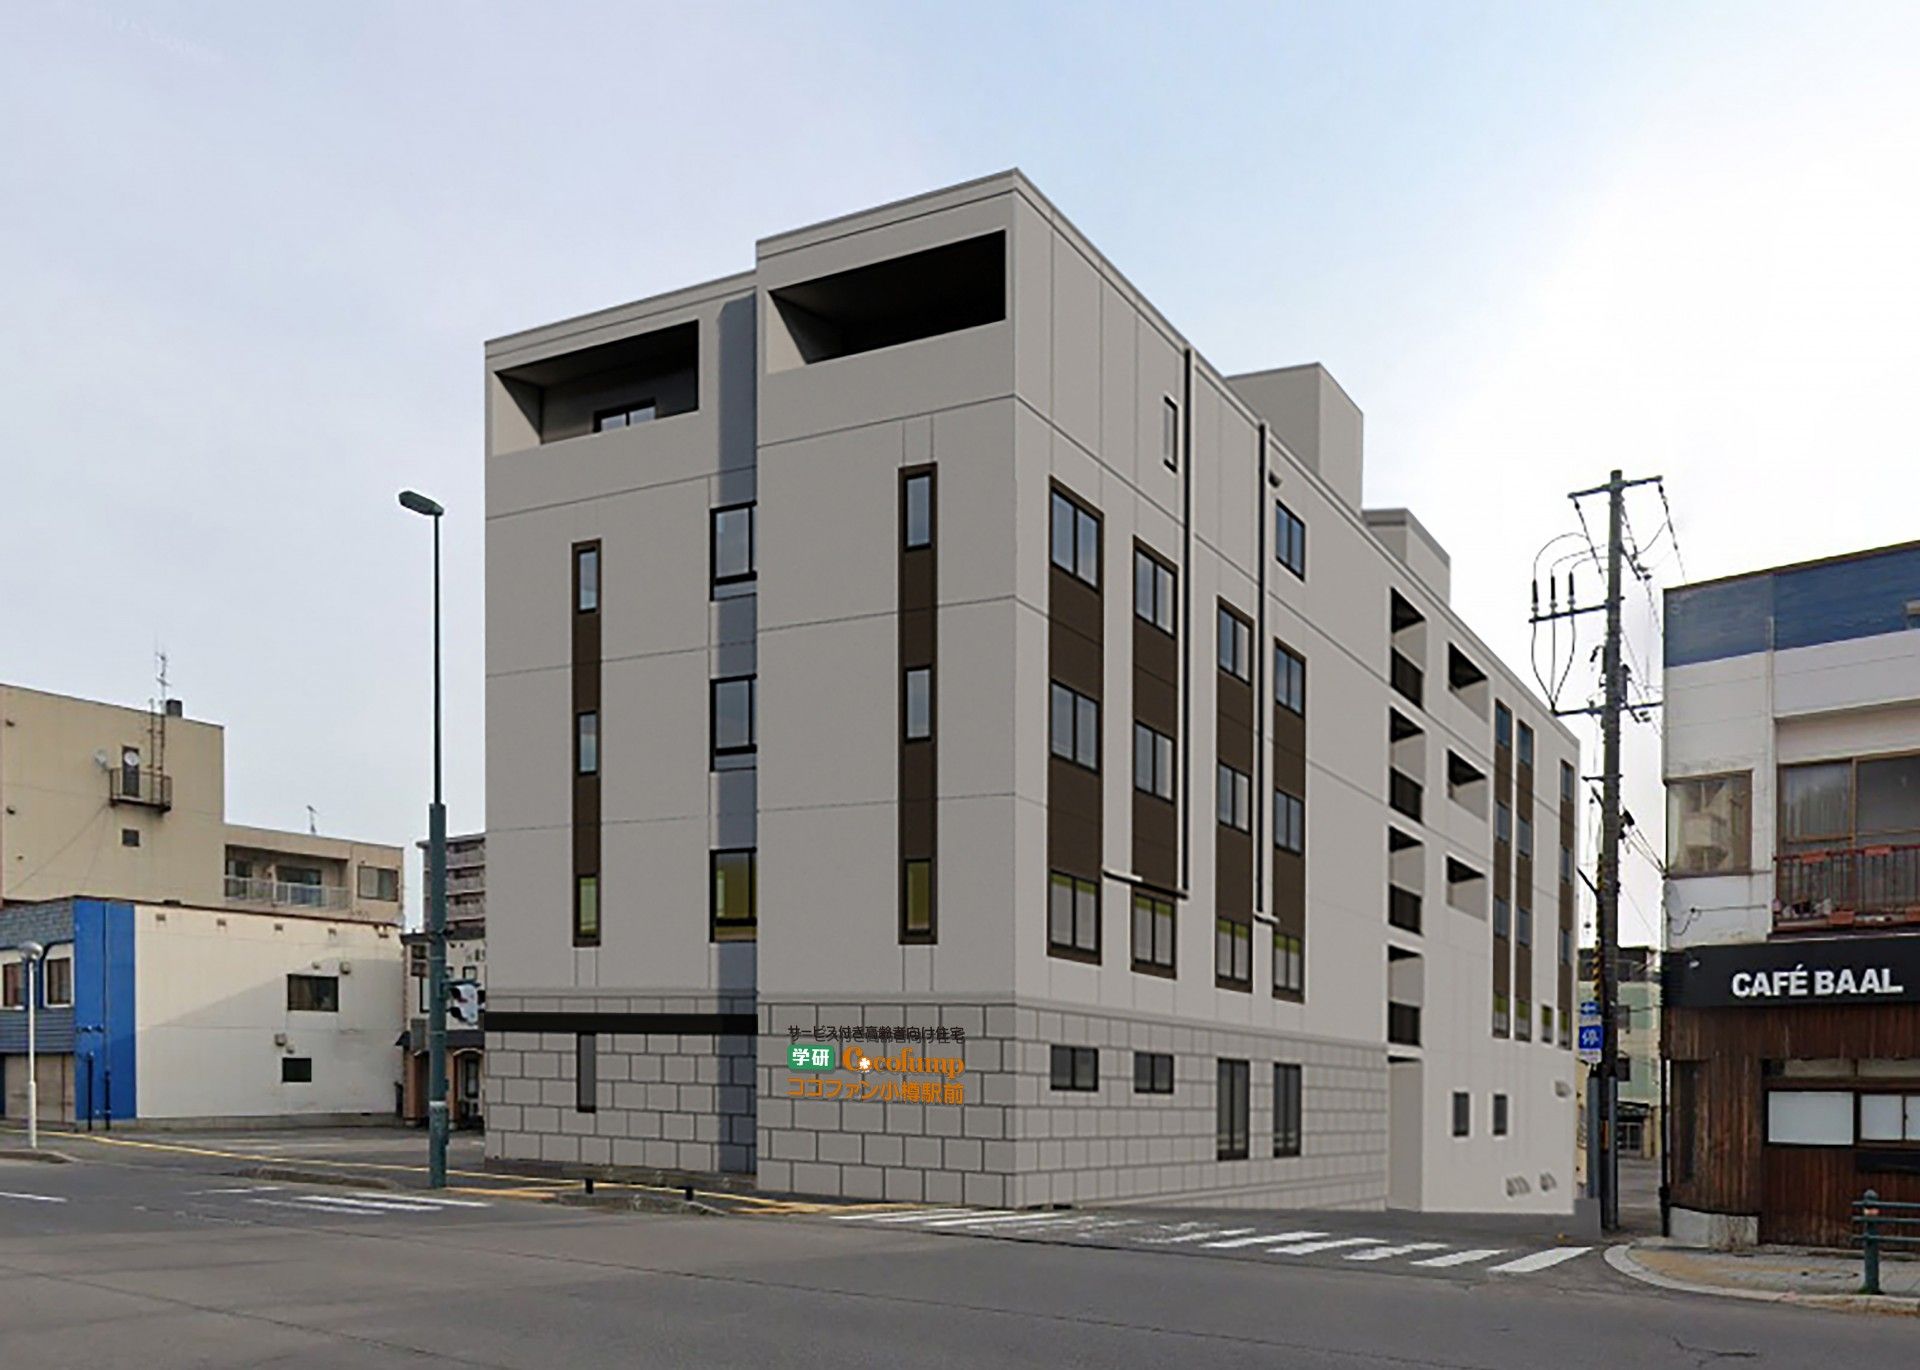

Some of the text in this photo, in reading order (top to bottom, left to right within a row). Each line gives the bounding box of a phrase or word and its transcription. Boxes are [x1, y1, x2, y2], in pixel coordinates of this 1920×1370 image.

[1732, 964, 1903, 997] CAFÉ BAAL
[792, 1048, 829, 1066] 学研
[787, 1077, 964, 1104] ココファン小樽駅前
